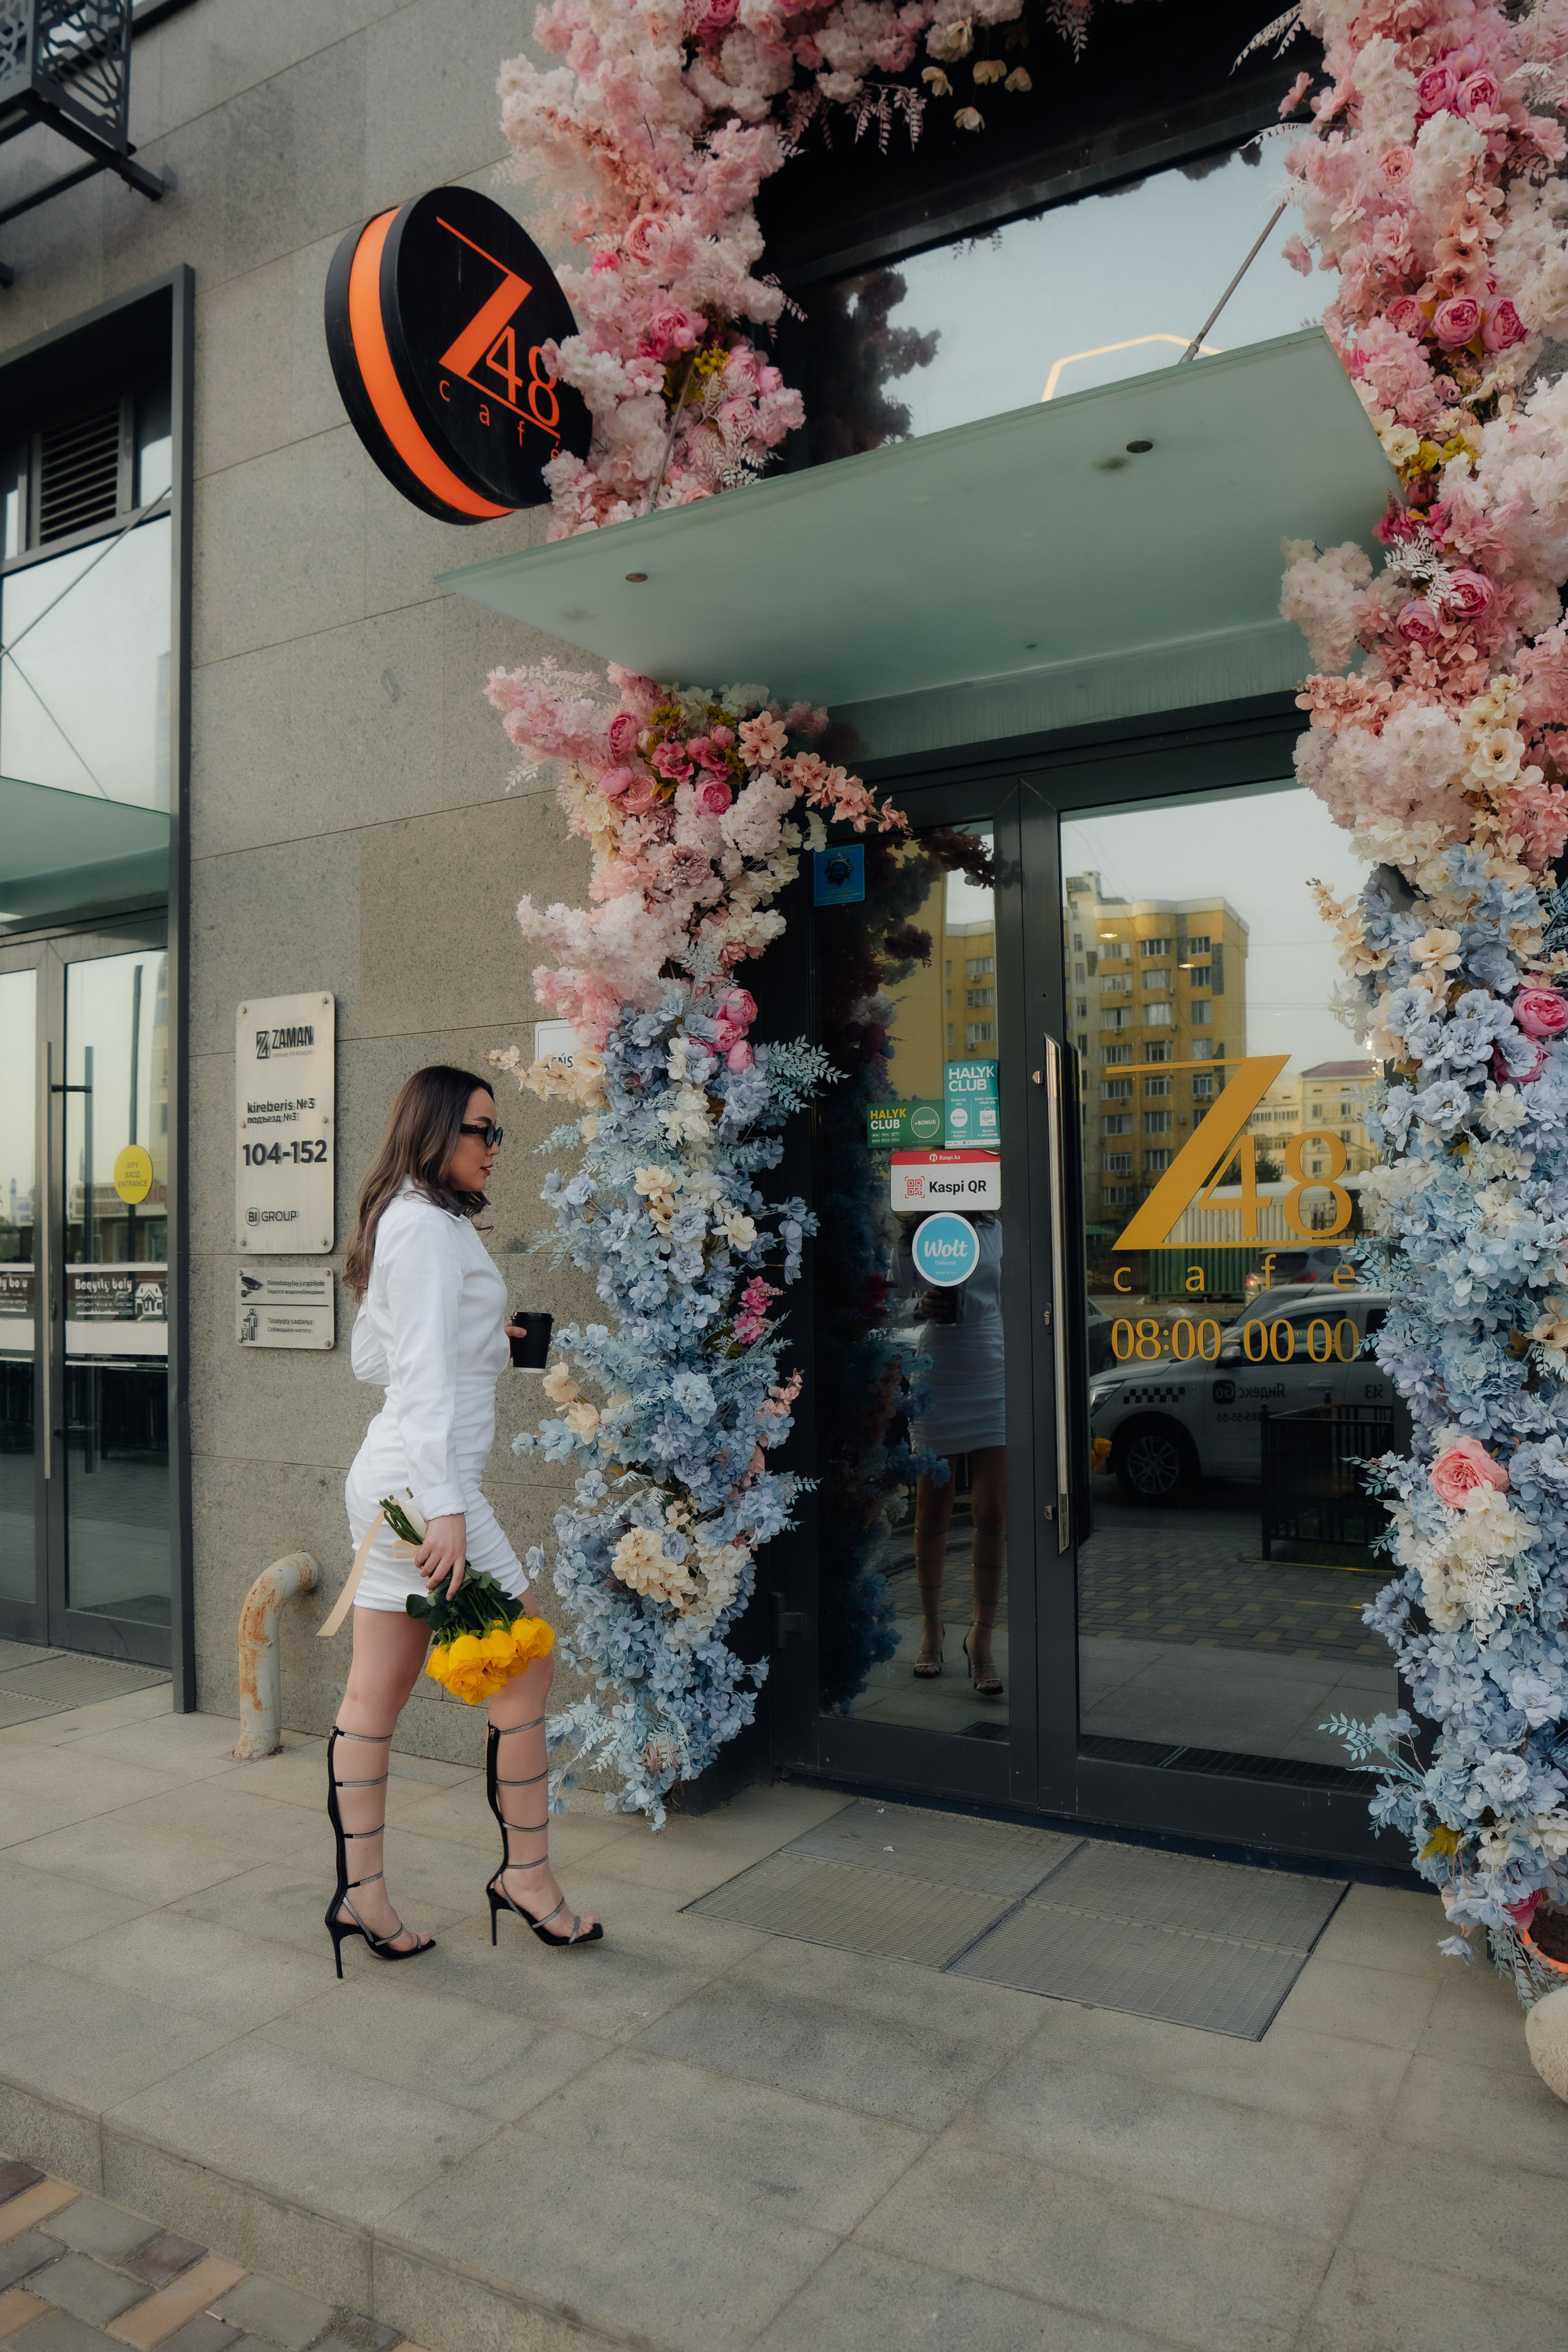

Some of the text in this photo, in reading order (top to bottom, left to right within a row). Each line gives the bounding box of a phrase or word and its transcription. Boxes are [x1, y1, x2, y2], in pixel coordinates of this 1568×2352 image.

[437, 216, 561, 440] Z48
[272, 1025, 314, 1049] ZAMAN
[949, 1066, 995, 1080] HALYK
[949, 1079, 987, 1092] CLUB
[247, 1098, 315, 1114] kireberis №3
[870, 1108, 907, 1120] HALYK
[247, 1115, 281, 1125] подъезд
[870, 1119, 900, 1130] CLUB
[243, 1139, 328, 1166] 104-152
[1106, 1054, 1354, 1250] Z48
[929, 1180, 987, 1196] Kaspi QR
[249, 1210, 298, 1222] BI GROUP
[924, 1239, 968, 1257] Wolt
